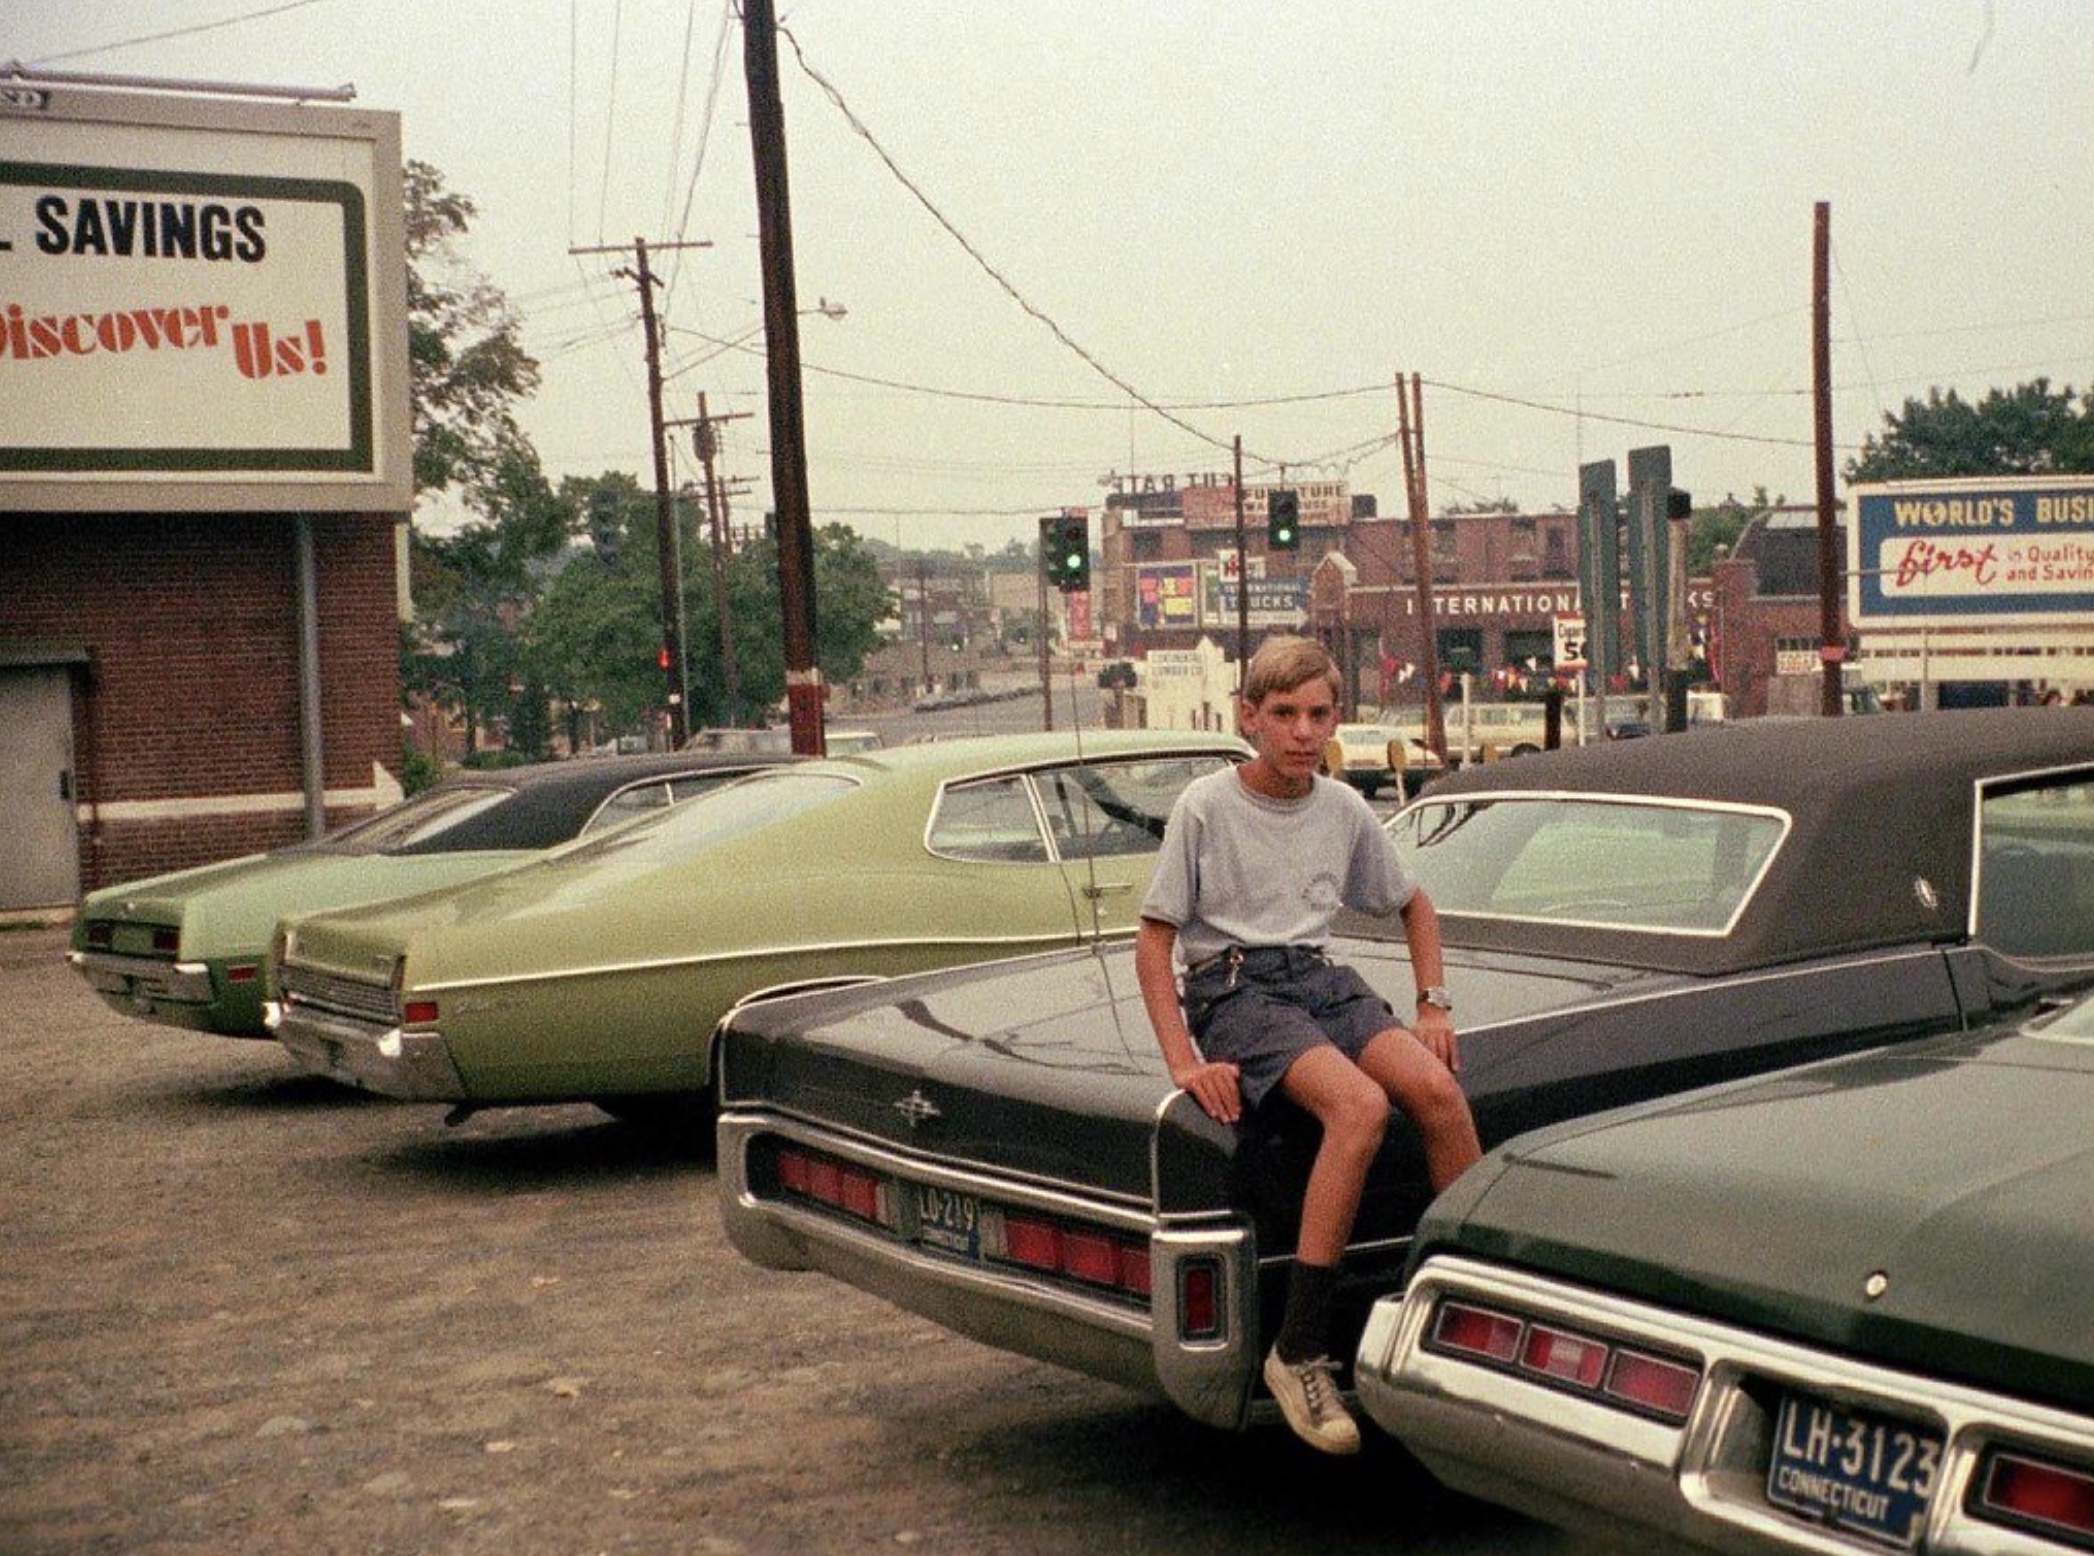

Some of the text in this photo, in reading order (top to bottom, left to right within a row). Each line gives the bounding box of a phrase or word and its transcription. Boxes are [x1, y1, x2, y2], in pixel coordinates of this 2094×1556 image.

[35, 195, 266, 263] SAVINGS
[0, 303, 327, 379] iscover Us!
[1894, 498, 2015, 528] WORLD'S
[2006, 565, 2037, 581] and
[1228, 595, 1294, 609] TUCKS
[1778, 1465, 1890, 1522] CONNECTICUT
